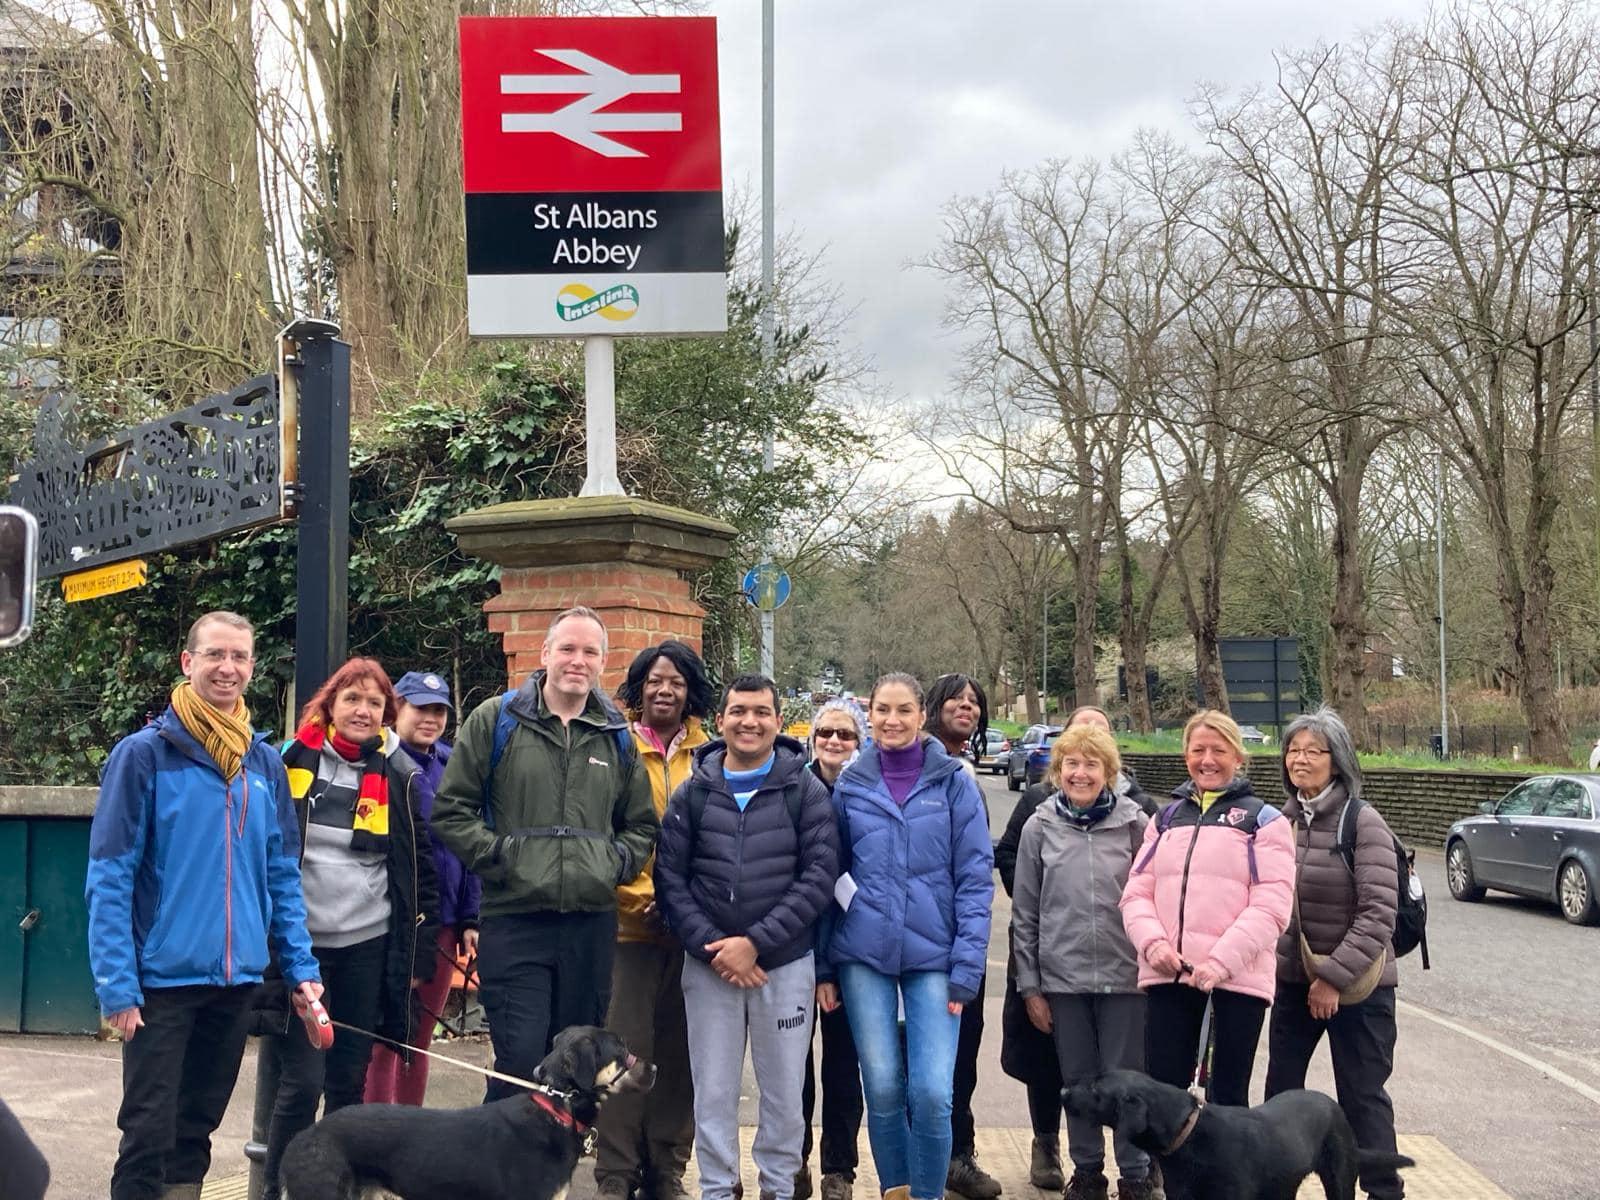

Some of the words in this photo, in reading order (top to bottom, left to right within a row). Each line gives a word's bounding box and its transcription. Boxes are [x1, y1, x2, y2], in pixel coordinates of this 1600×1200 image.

[534, 204, 561, 229] St
[566, 202, 658, 229] Albans
[552, 238, 642, 270] Abbey
[563, 285, 633, 321] Intalink
[68, 580, 96, 594] MAXIMUM
[98, 574, 120, 589] HEIGHT
[778, 1014, 804, 1029] PUMA
